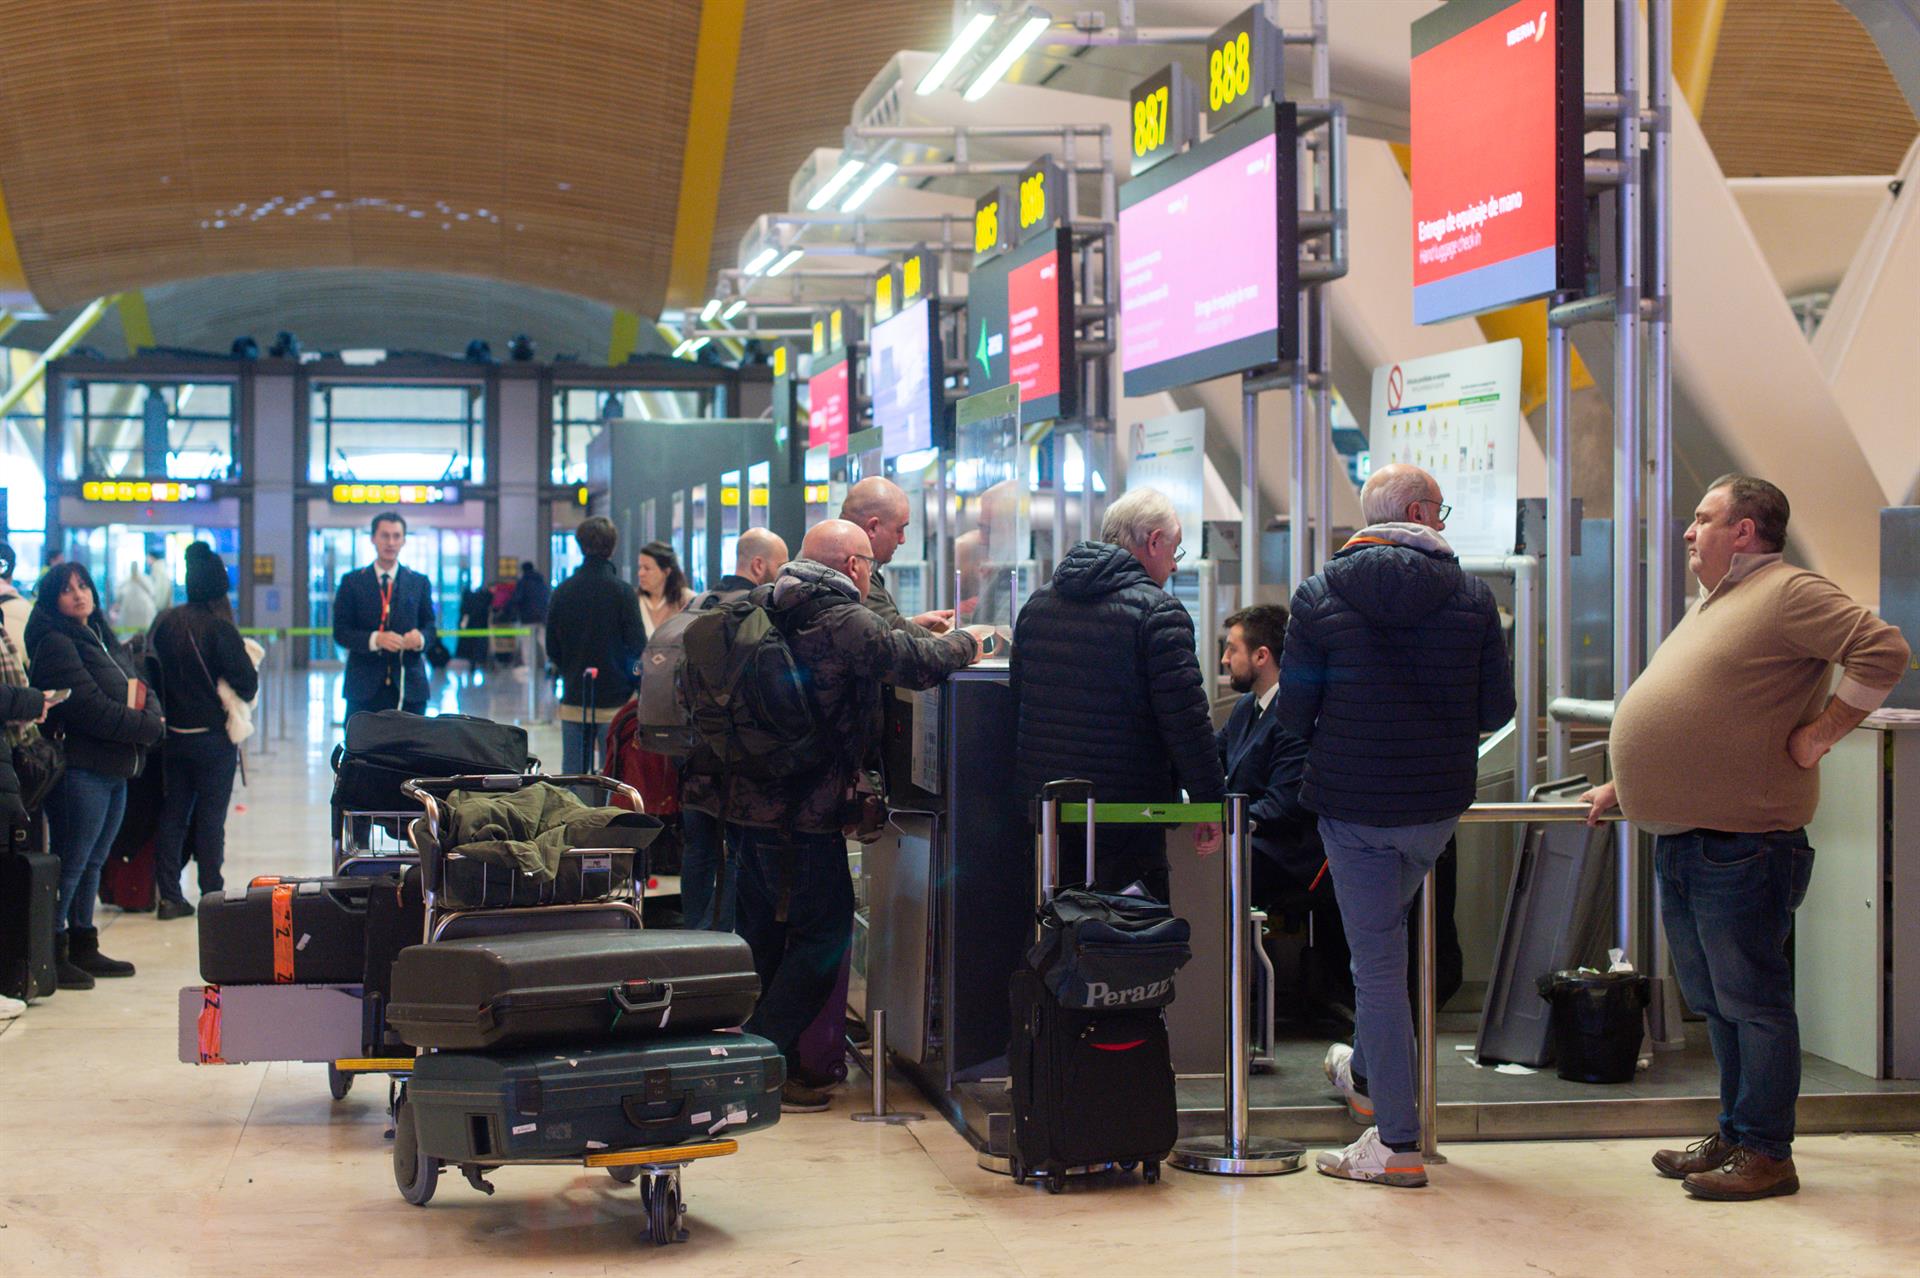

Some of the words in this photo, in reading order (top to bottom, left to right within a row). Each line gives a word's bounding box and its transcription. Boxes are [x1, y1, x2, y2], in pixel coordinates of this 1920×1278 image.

[1210, 32, 1250, 111] 888
[1134, 86, 1168, 157] 887
[1488, 195, 1498, 218] de
[1499, 191, 1523, 214] mano
